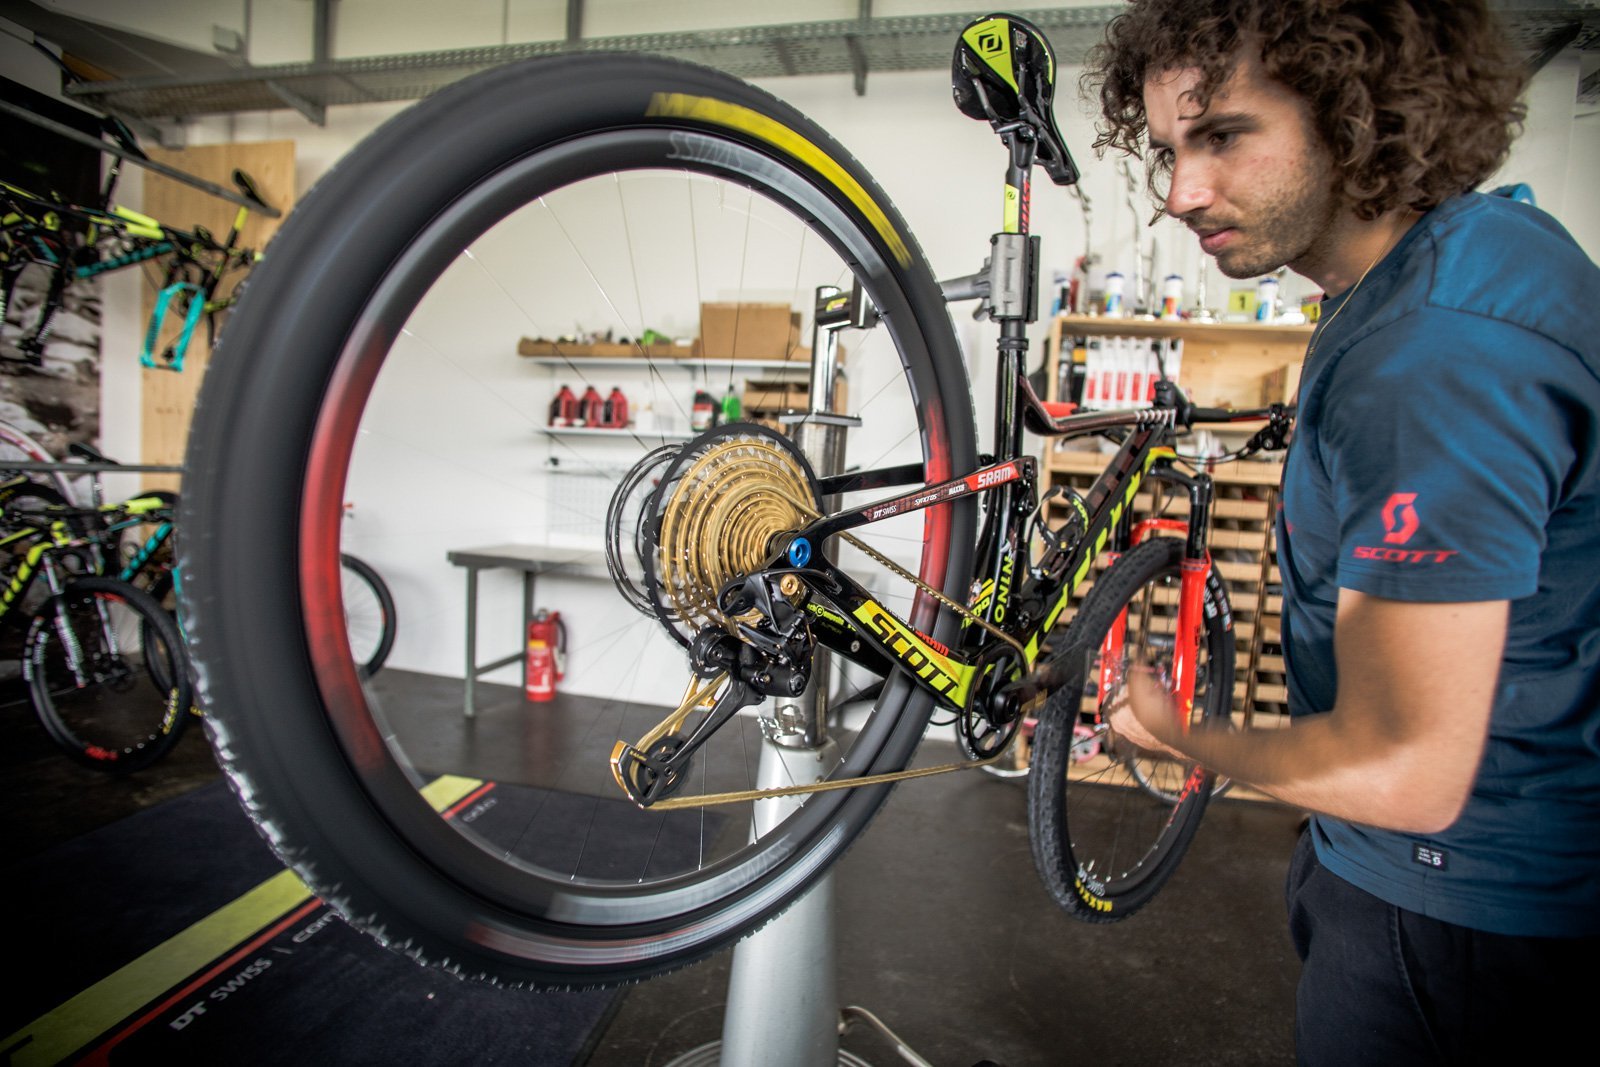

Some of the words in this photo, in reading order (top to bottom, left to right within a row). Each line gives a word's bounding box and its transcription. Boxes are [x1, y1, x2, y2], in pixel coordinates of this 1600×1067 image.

[977, 466, 1011, 489] SRAM
[873, 510, 883, 519] DT
[882, 504, 897, 517] SWISS
[1353, 546, 1459, 564] SCOTT
[863, 612, 959, 696] SCOTT
[169, 1001, 207, 1031] DT
[209, 957, 273, 1001] SWISS
